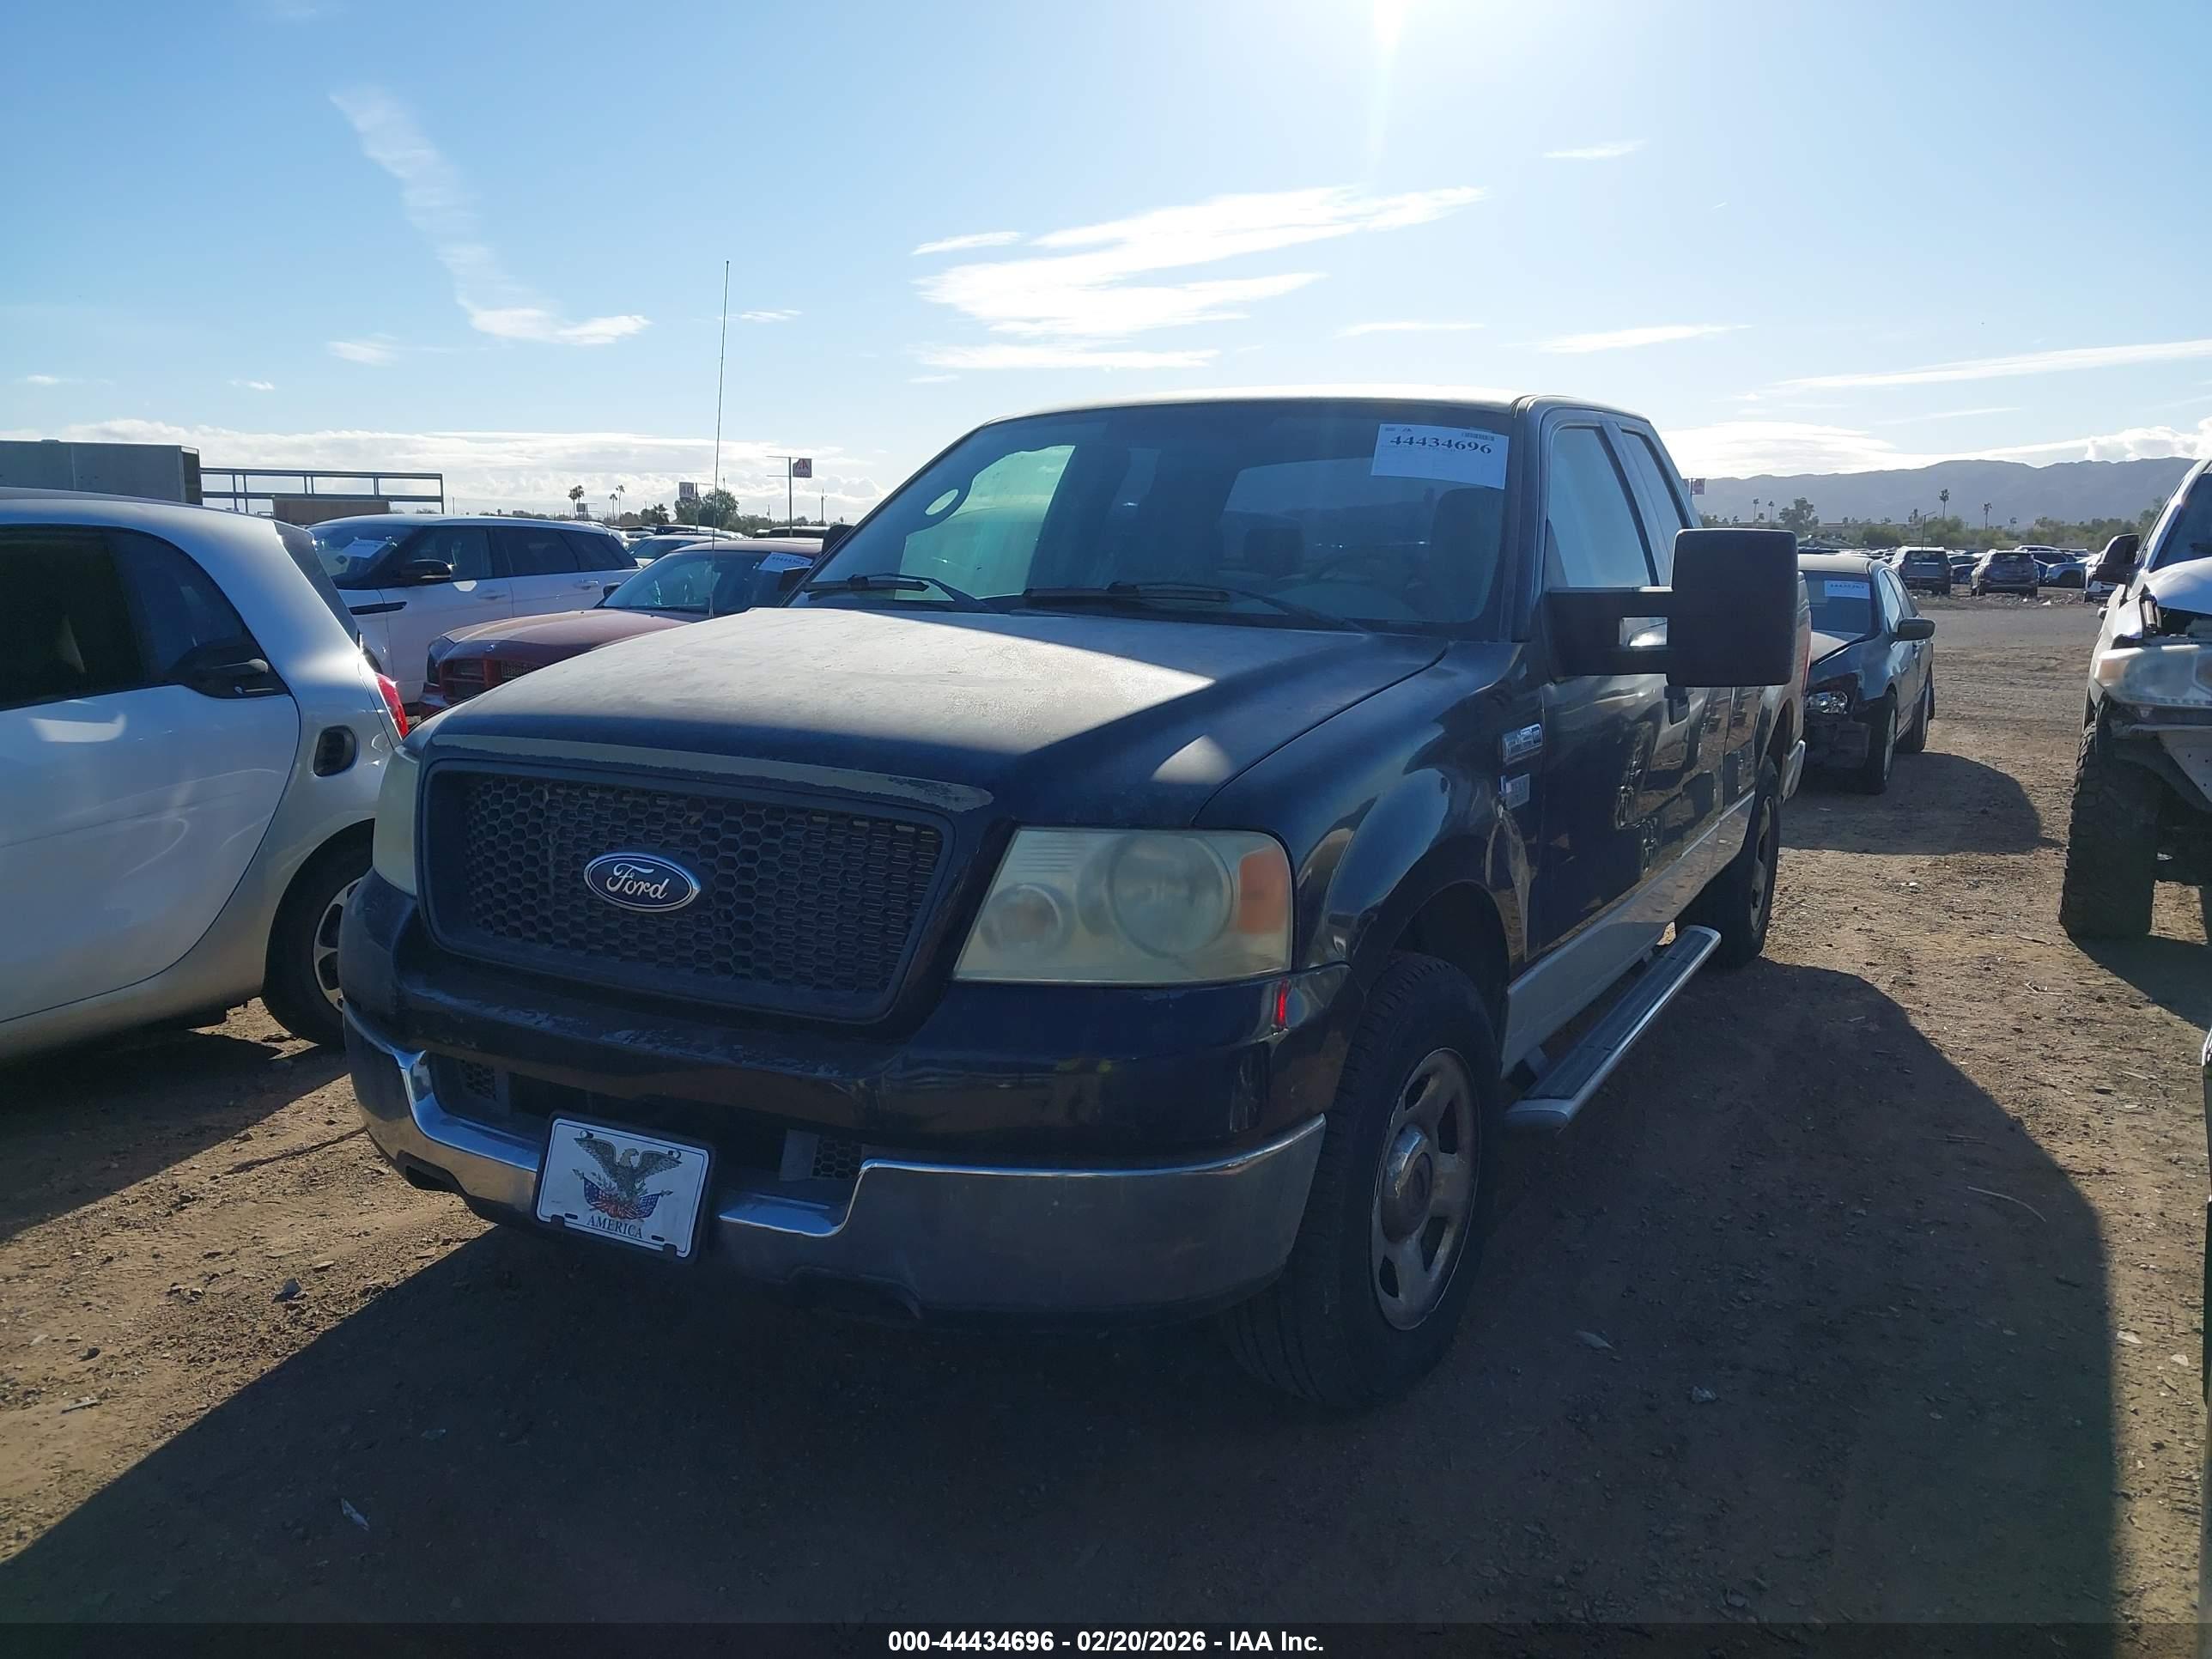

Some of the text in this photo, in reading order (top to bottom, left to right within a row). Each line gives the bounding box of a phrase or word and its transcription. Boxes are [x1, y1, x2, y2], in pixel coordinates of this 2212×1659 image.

[1389, 434, 1492, 454] 44434696
[605, 862, 670, 900] Ford
[586, 1216, 644, 1239] AMERICA
